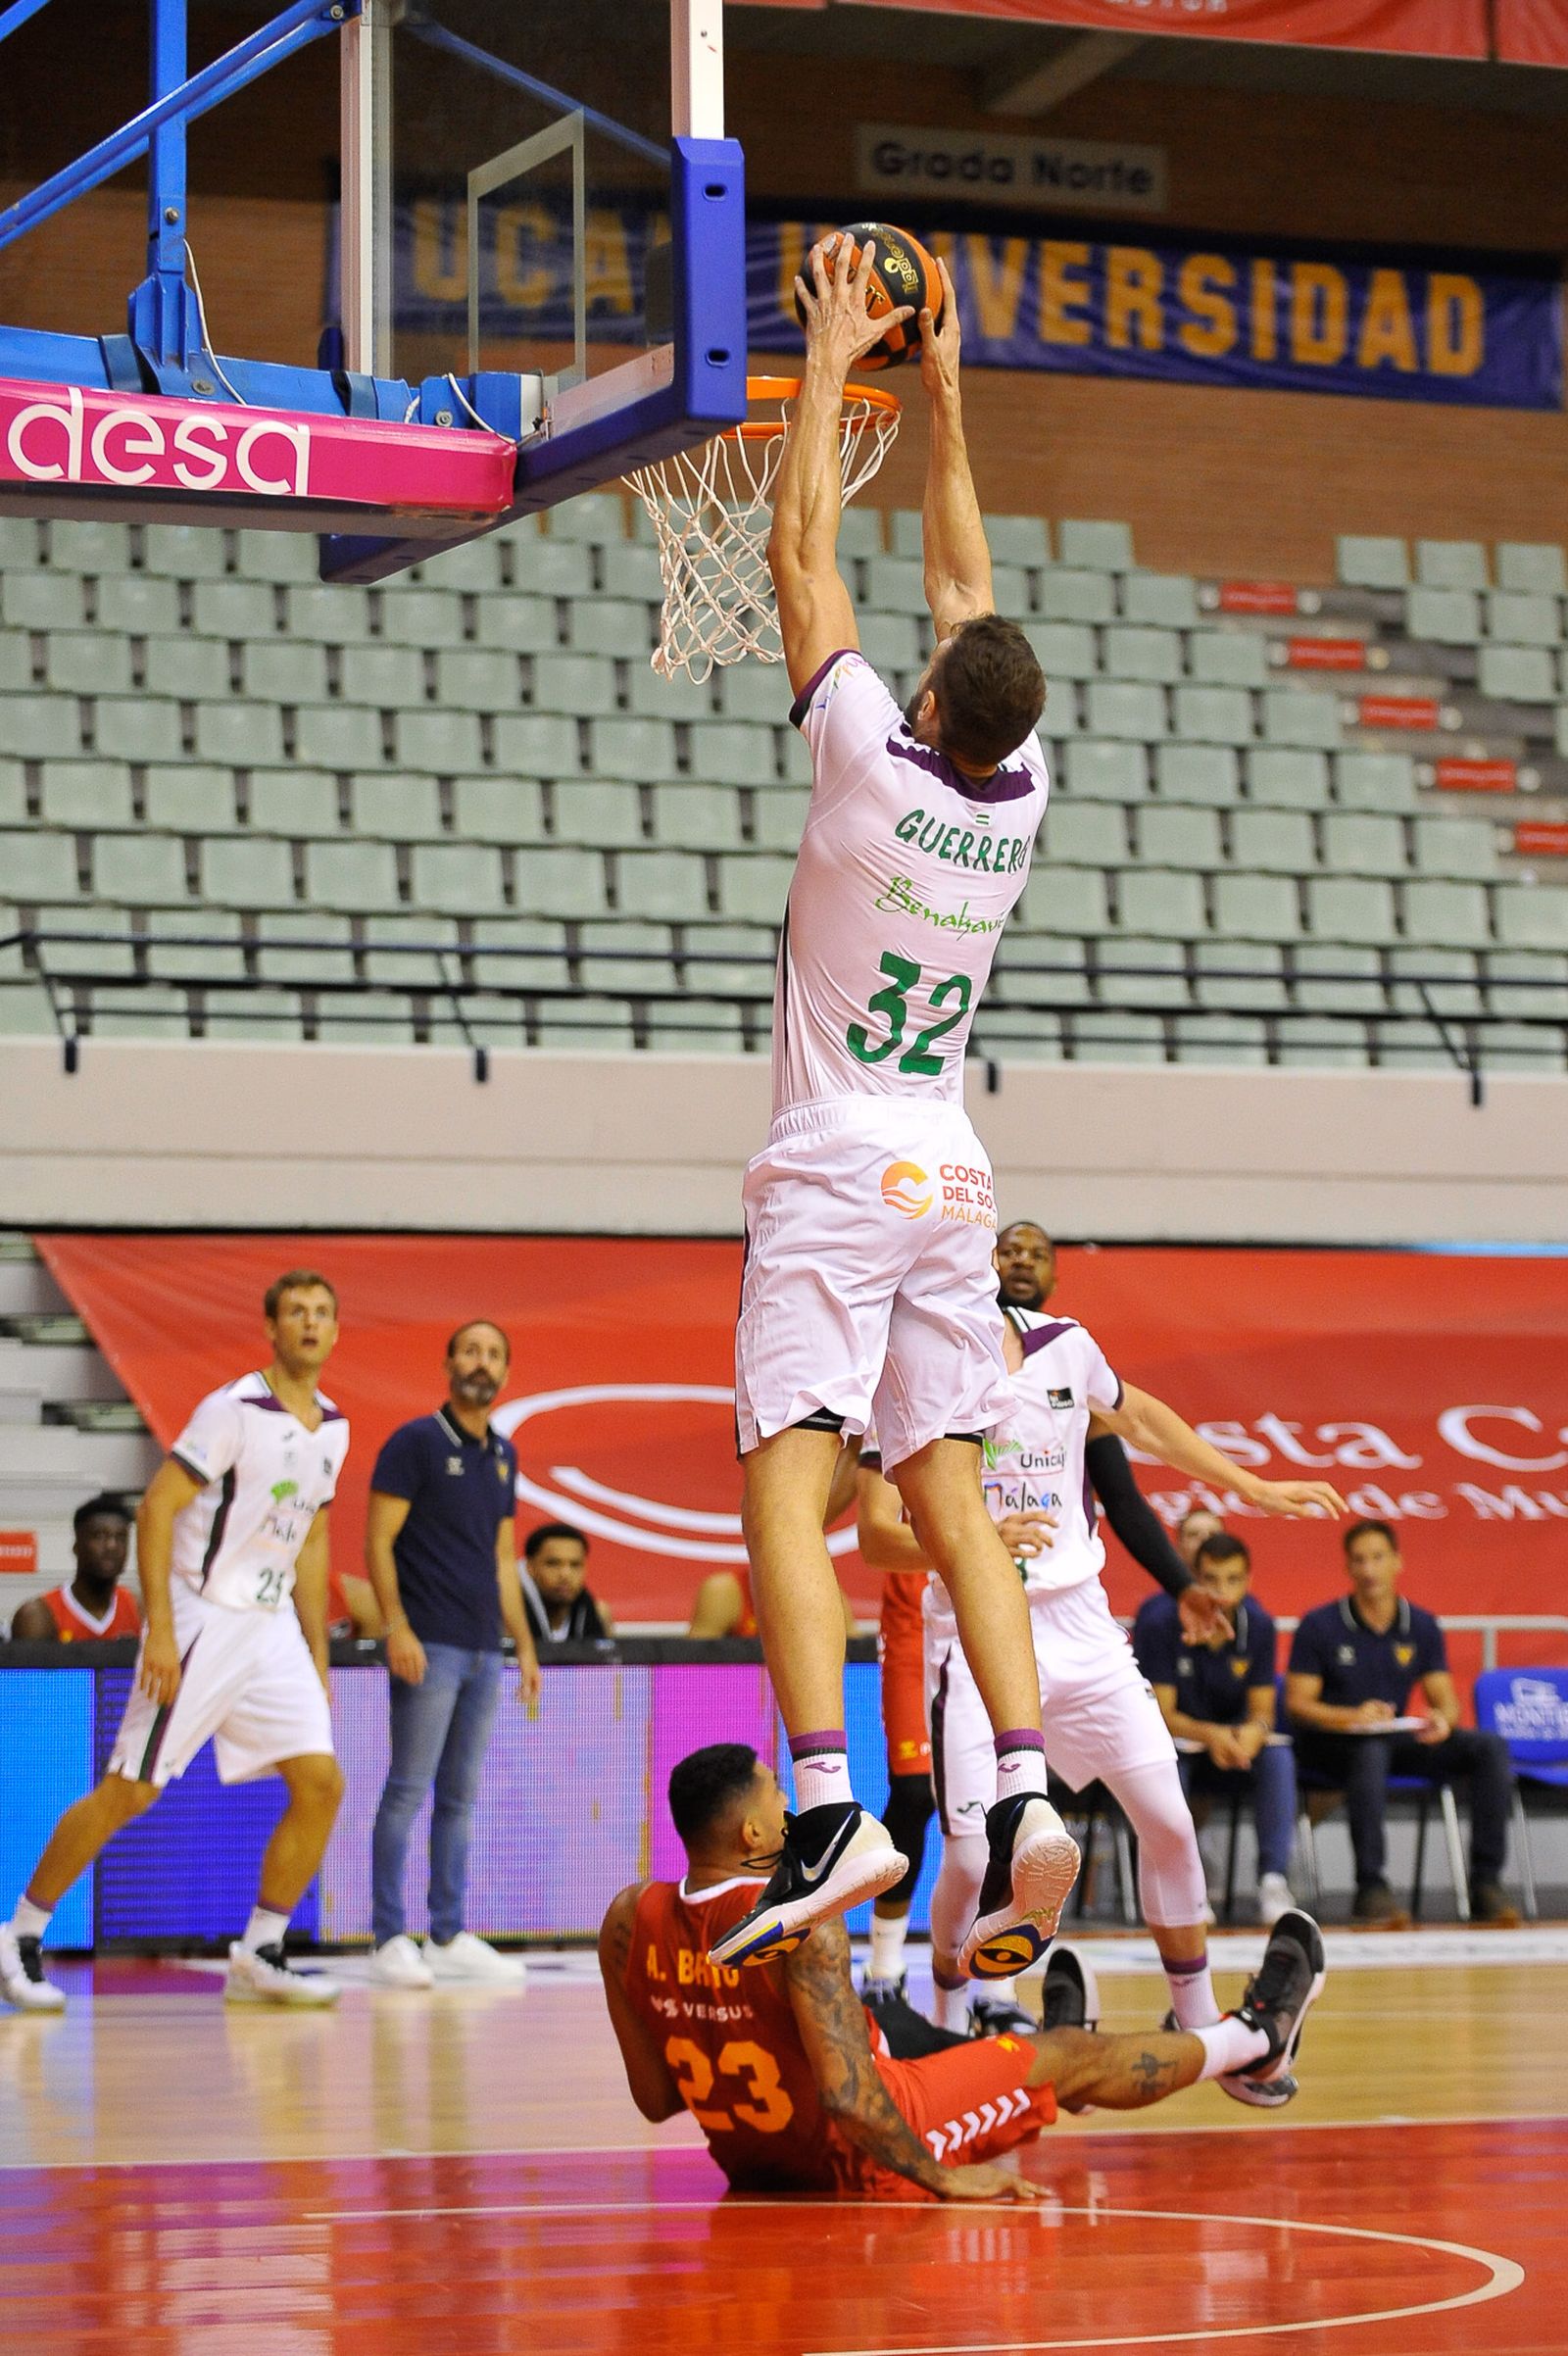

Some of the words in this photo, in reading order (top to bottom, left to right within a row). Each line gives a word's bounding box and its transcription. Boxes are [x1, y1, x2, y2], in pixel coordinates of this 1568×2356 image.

[872, 140, 1015, 184] Grada
[1032, 152, 1154, 194] Norte
[412, 200, 672, 316] UCA
[8, 386, 311, 497] desa
[895, 809, 1031, 874] GUERRERO
[847, 951, 973, 1077] 32
[940, 1164, 992, 1191] COSTA
[943, 1186, 974, 1203] DEL
[977, 1192, 996, 1213] SO
[1437, 1404, 1568, 1472] C
[646, 1943, 667, 1983] A.
[683, 2001, 755, 2023] VERSUS
[665, 2036, 795, 2134] 23
